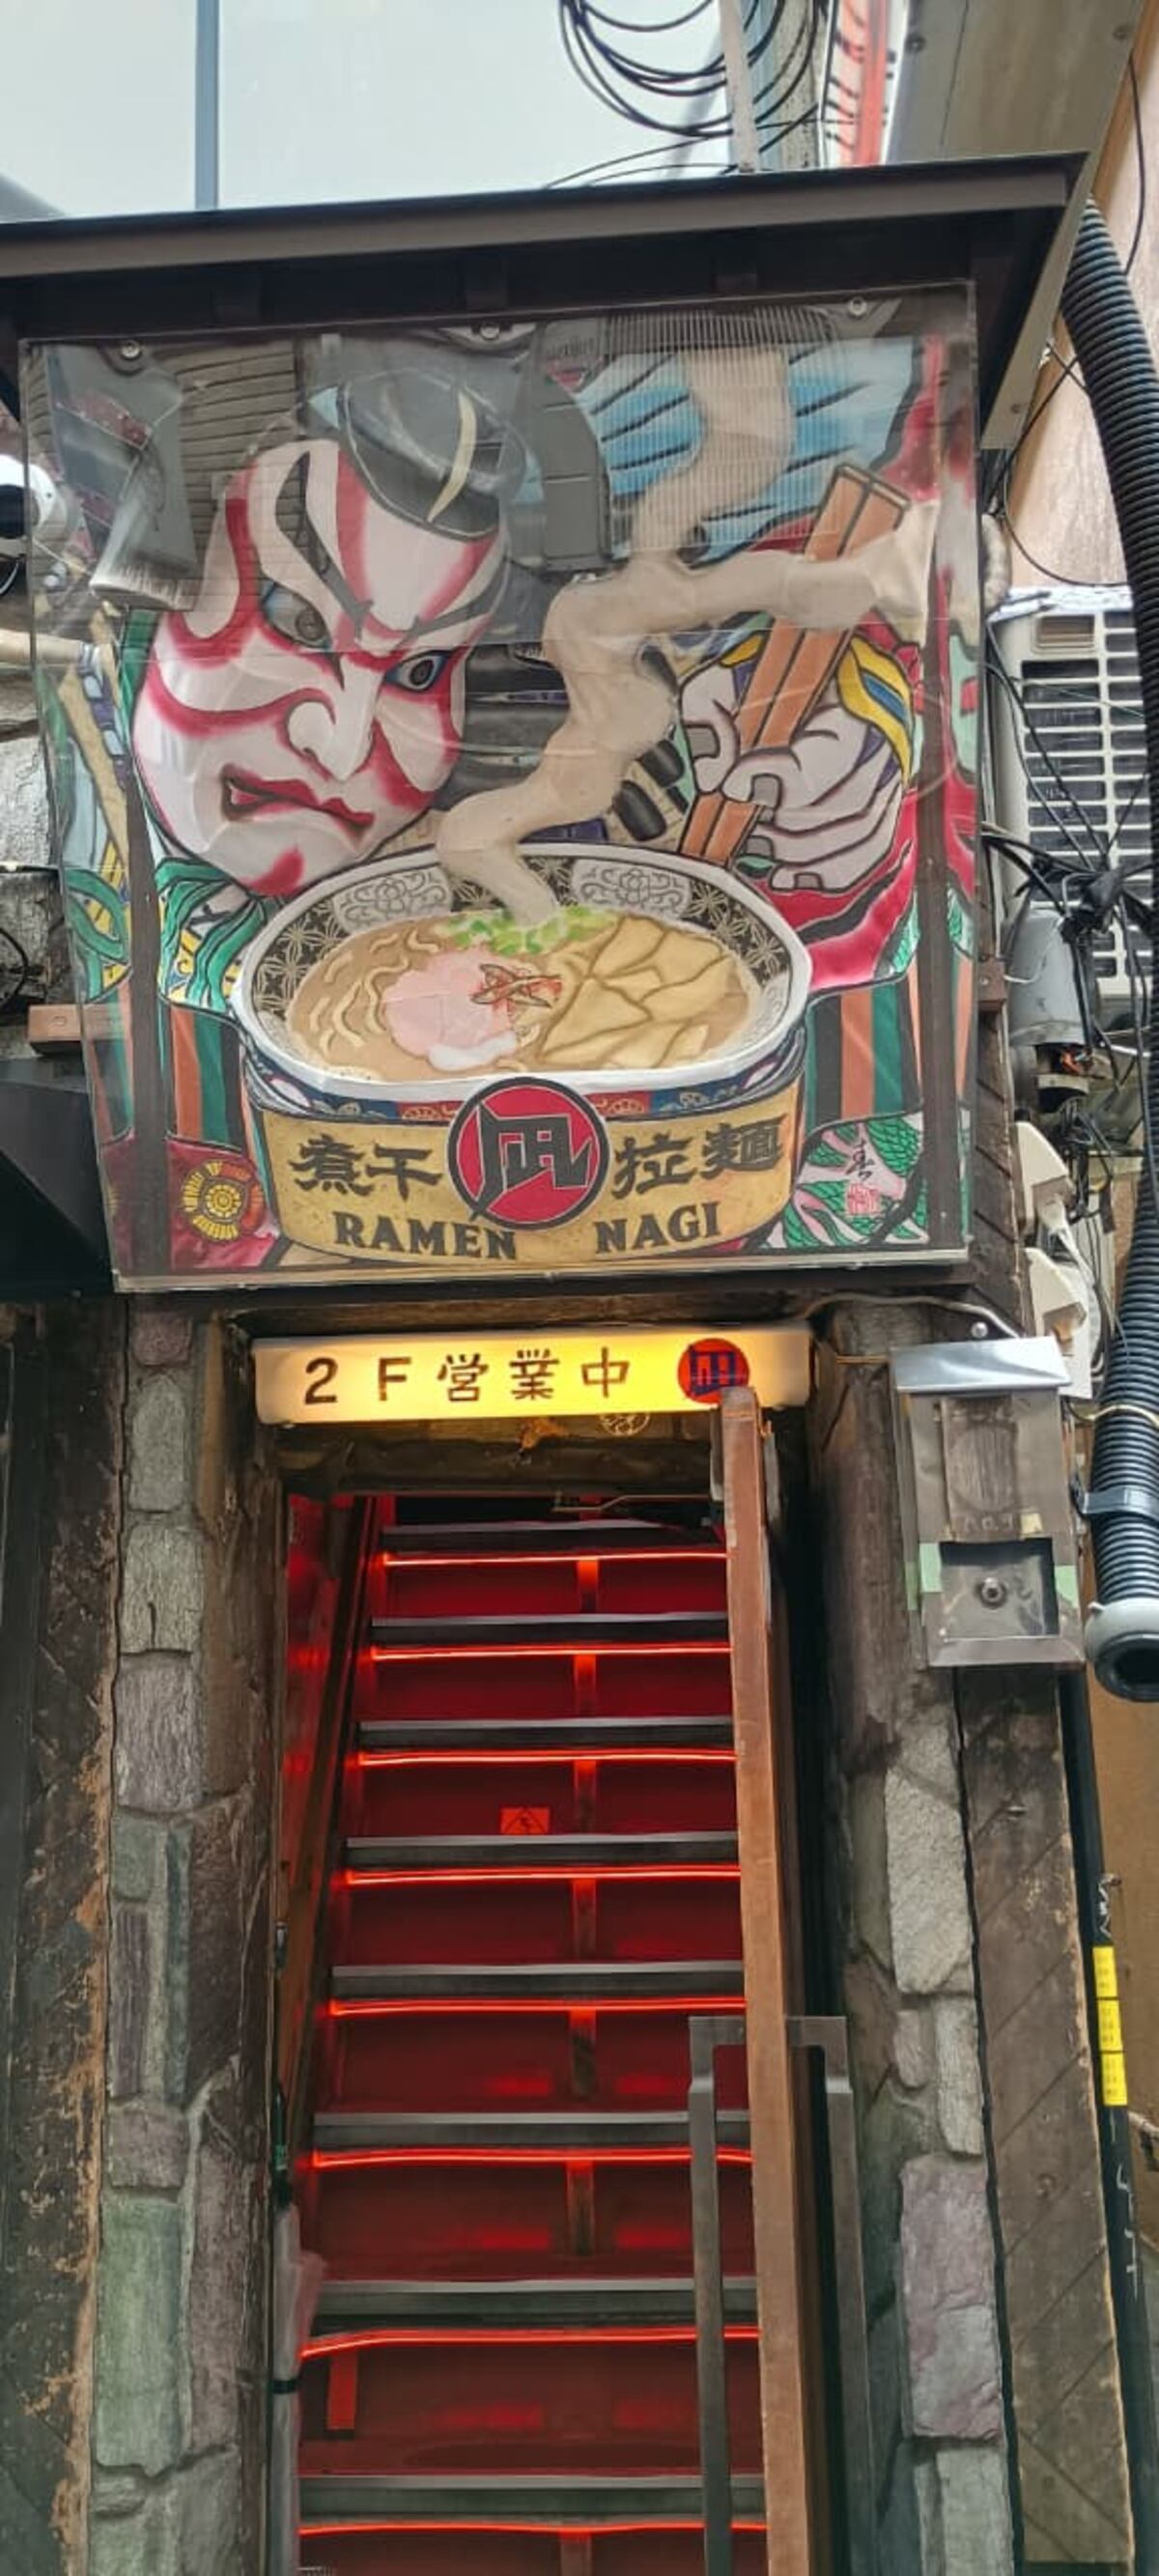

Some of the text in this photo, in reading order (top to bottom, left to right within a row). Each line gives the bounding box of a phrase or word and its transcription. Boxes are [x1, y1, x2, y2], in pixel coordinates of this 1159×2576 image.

[289, 1133, 443, 1202] 煮干
[332, 1201, 721, 1260] RAMEN NAGI
